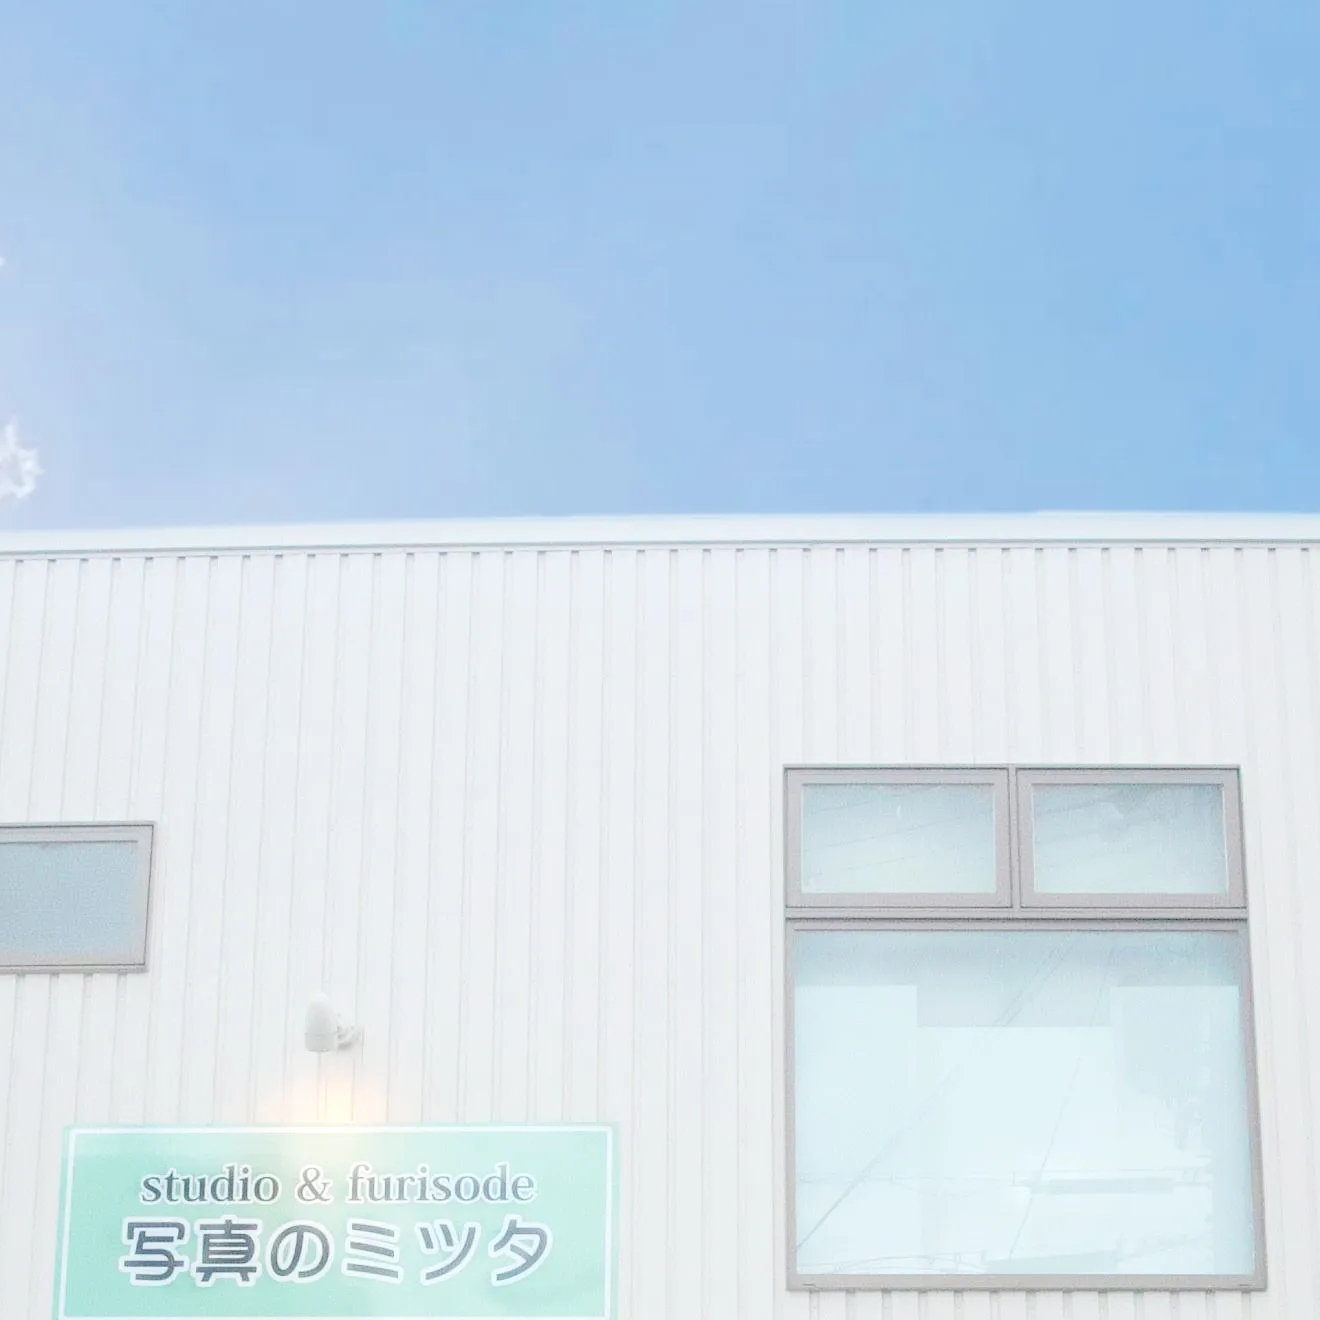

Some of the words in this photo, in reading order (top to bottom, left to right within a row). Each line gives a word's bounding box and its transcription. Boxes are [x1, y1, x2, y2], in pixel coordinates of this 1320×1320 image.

[142, 1164, 280, 1202] studio
[296, 1167, 331, 1202] &
[348, 1163, 535, 1202] furisode
[123, 1219, 550, 1284] 写真のミツタ
